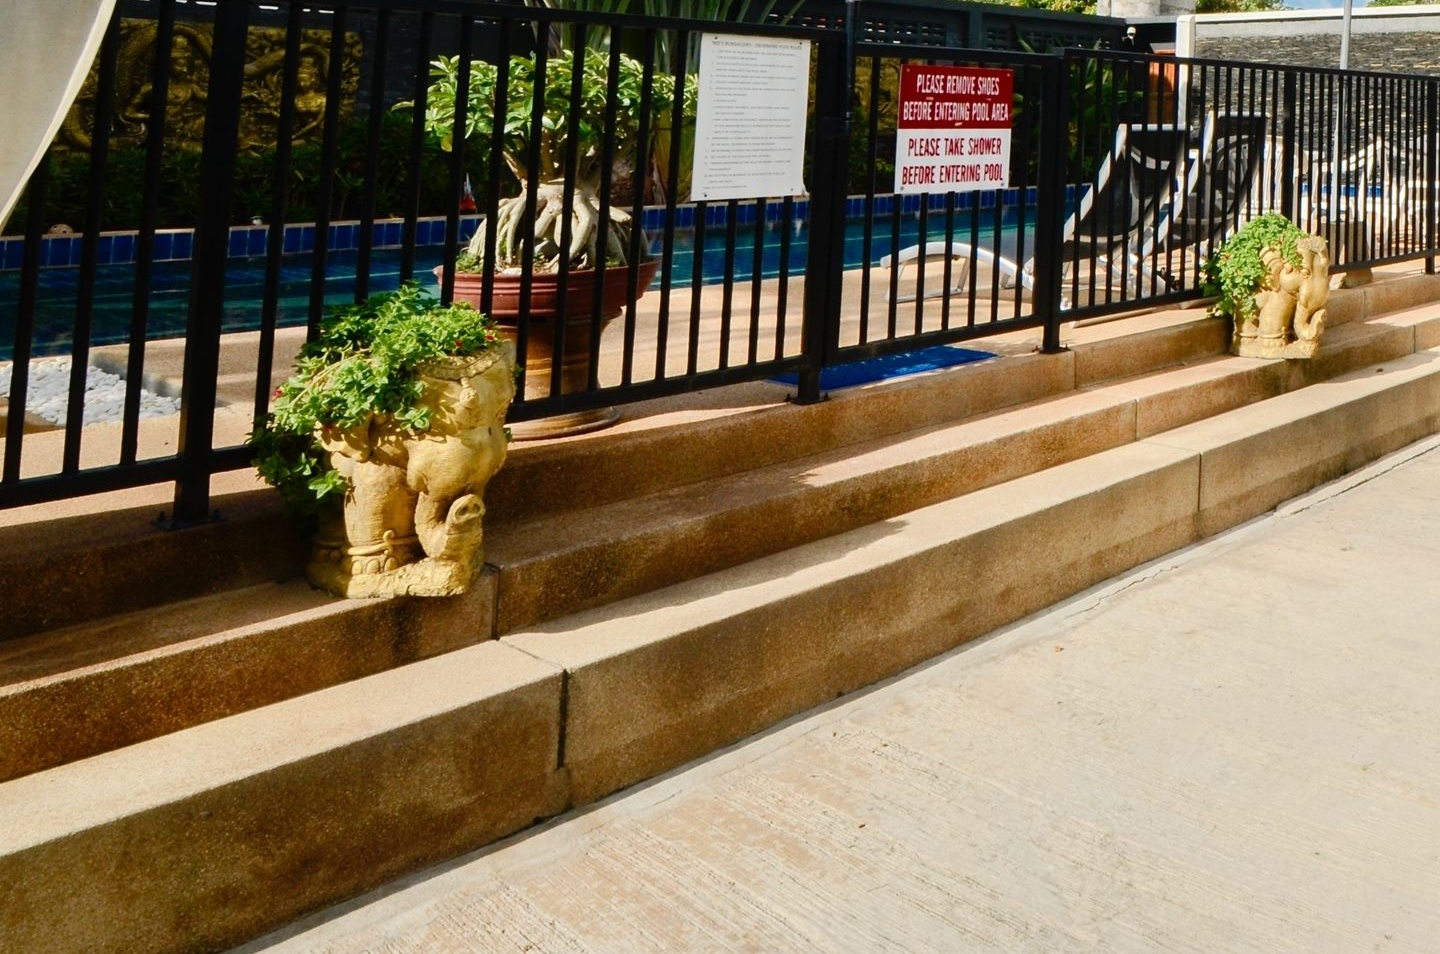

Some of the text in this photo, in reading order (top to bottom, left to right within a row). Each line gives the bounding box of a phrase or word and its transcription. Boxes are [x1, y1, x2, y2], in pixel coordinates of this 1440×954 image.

[916, 74, 1000, 96] PLEASE REMOVE SHOES
[903, 101, 1009, 122] BEFORE ENTERING POOL AREA
[907, 137, 1002, 157] PLEASE TAKE SHOWER
[902, 163, 1004, 185] BEFORE ENTERING POOL
